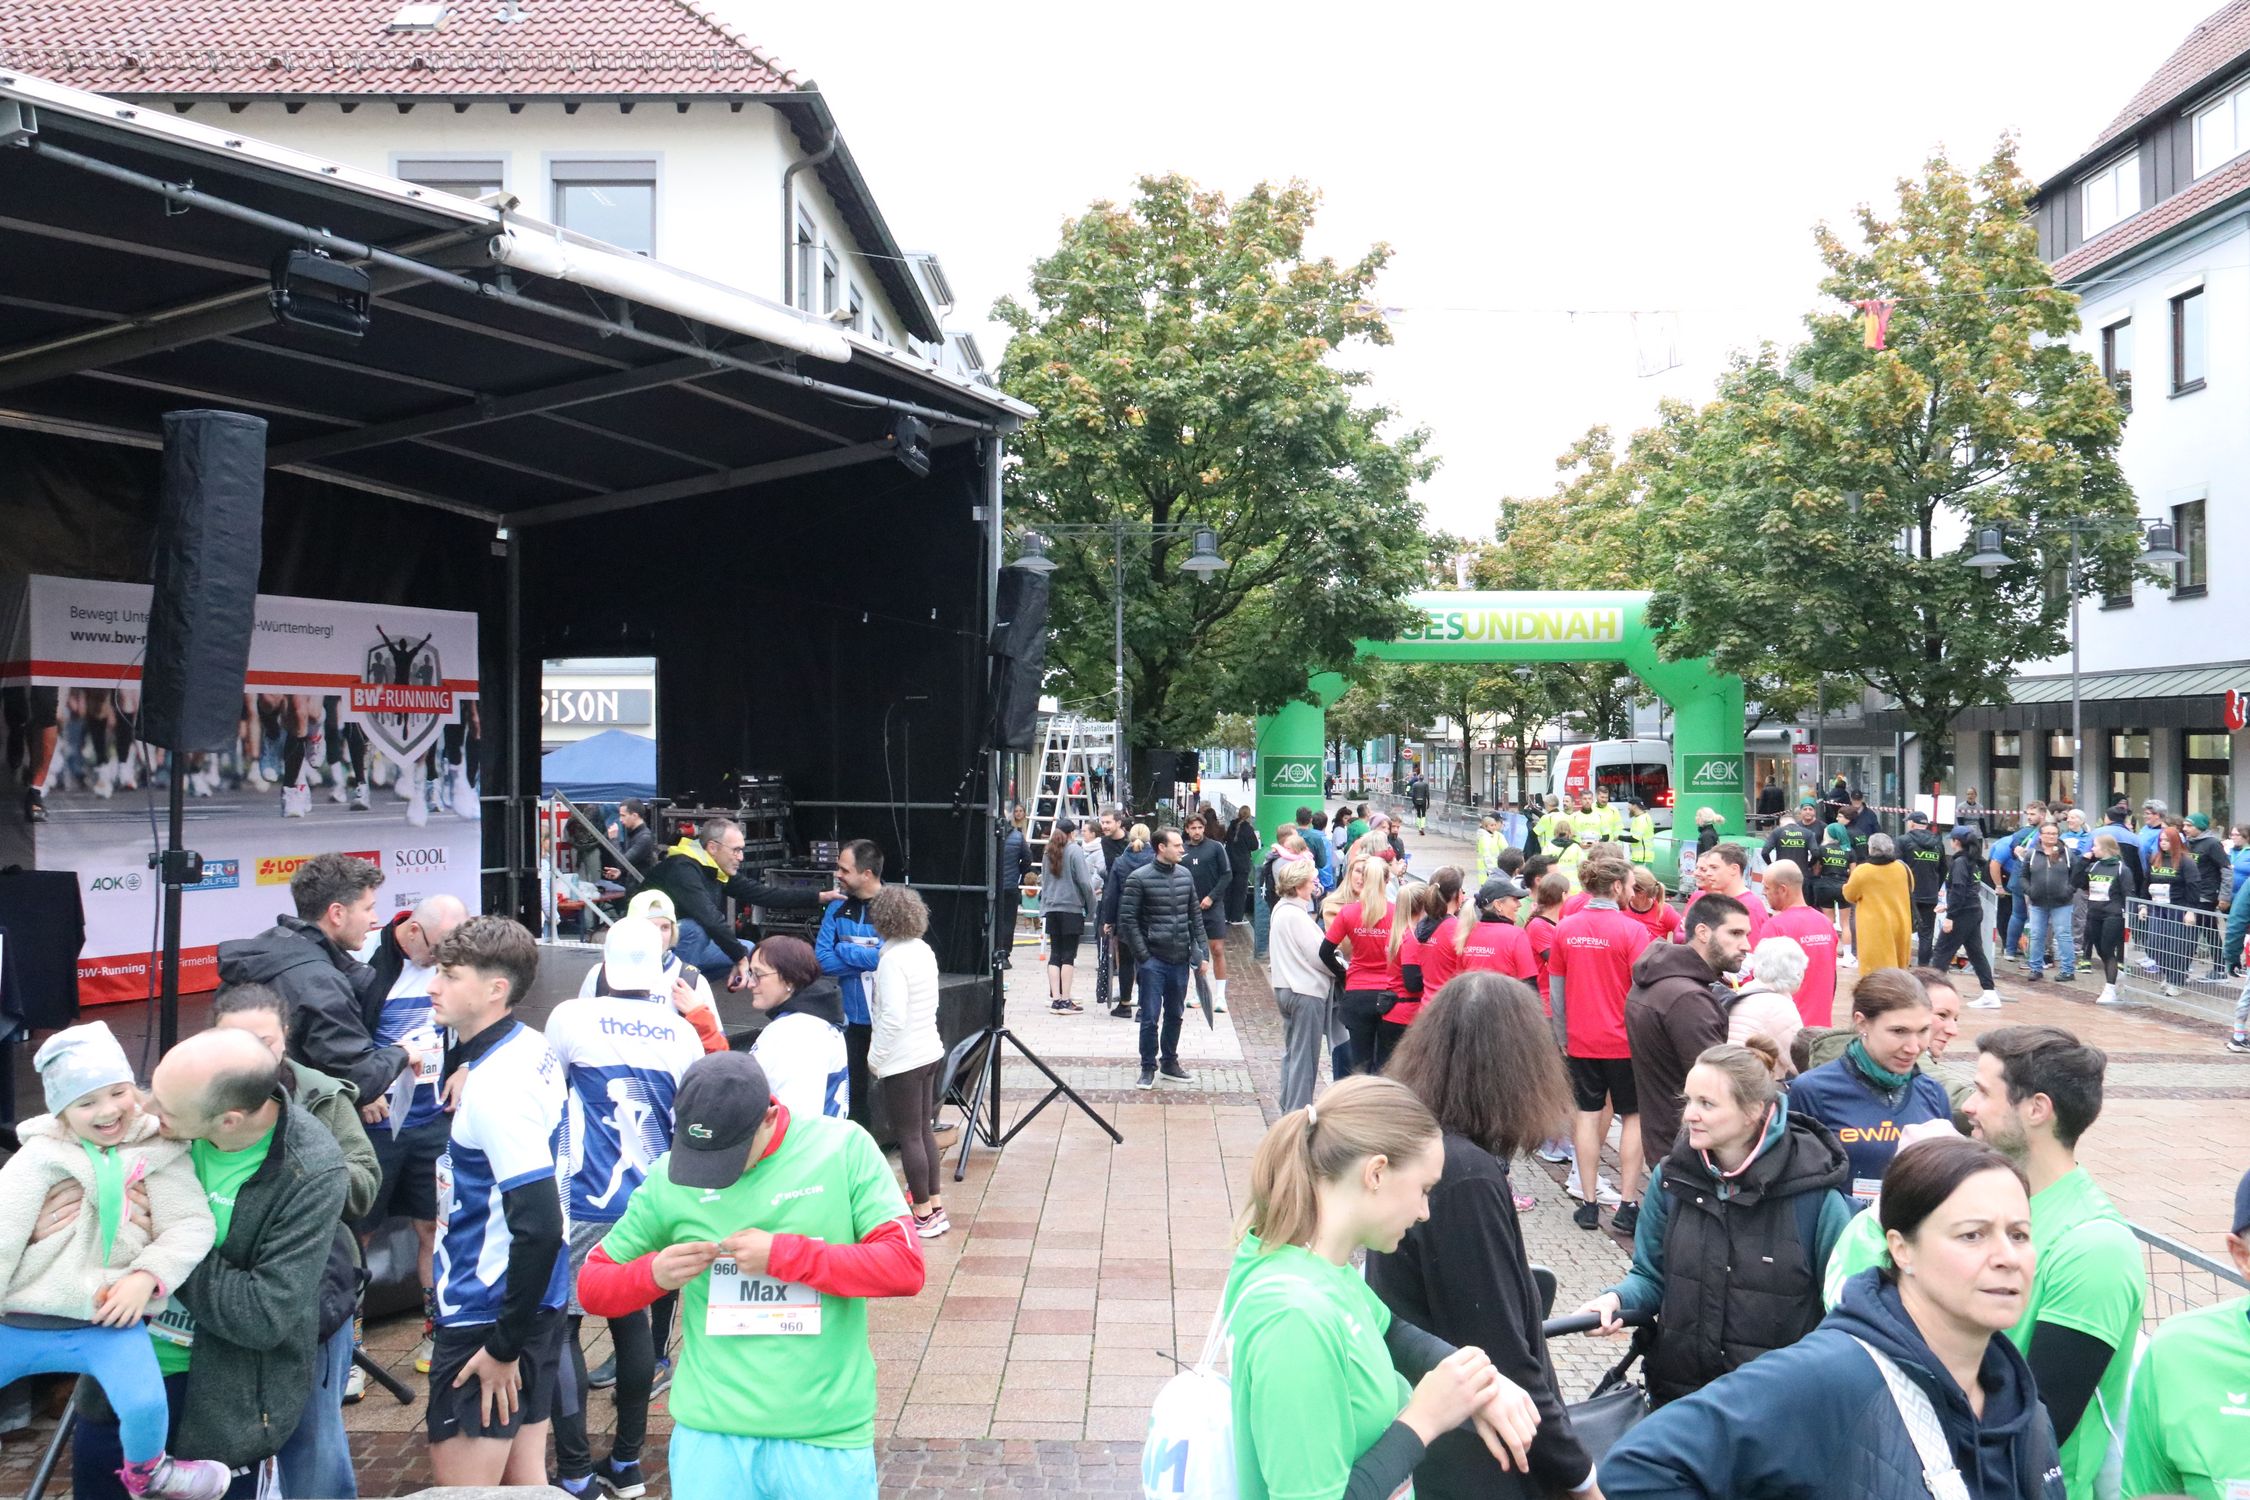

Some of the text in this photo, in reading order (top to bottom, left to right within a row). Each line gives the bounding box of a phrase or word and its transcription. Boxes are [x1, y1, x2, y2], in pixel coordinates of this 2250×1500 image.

[70, 606, 118, 623] Bewegt
[354, 688, 450, 709] BW-RUNNING
[1272, 764, 1317, 782] AOK
[1694, 761, 1738, 780] AOK
[1784, 829, 1803, 837] Team
[396, 849, 446, 866] S.COOL
[1826, 848, 1846, 856] Team
[90, 876, 124, 891] AOK
[77, 963, 146, 979] BW-Running
[599, 1016, 676, 1043] theben
[713, 1263, 738, 1276] 960
[739, 1280, 789, 1302] Max
[780, 1321, 804, 1332] 960
